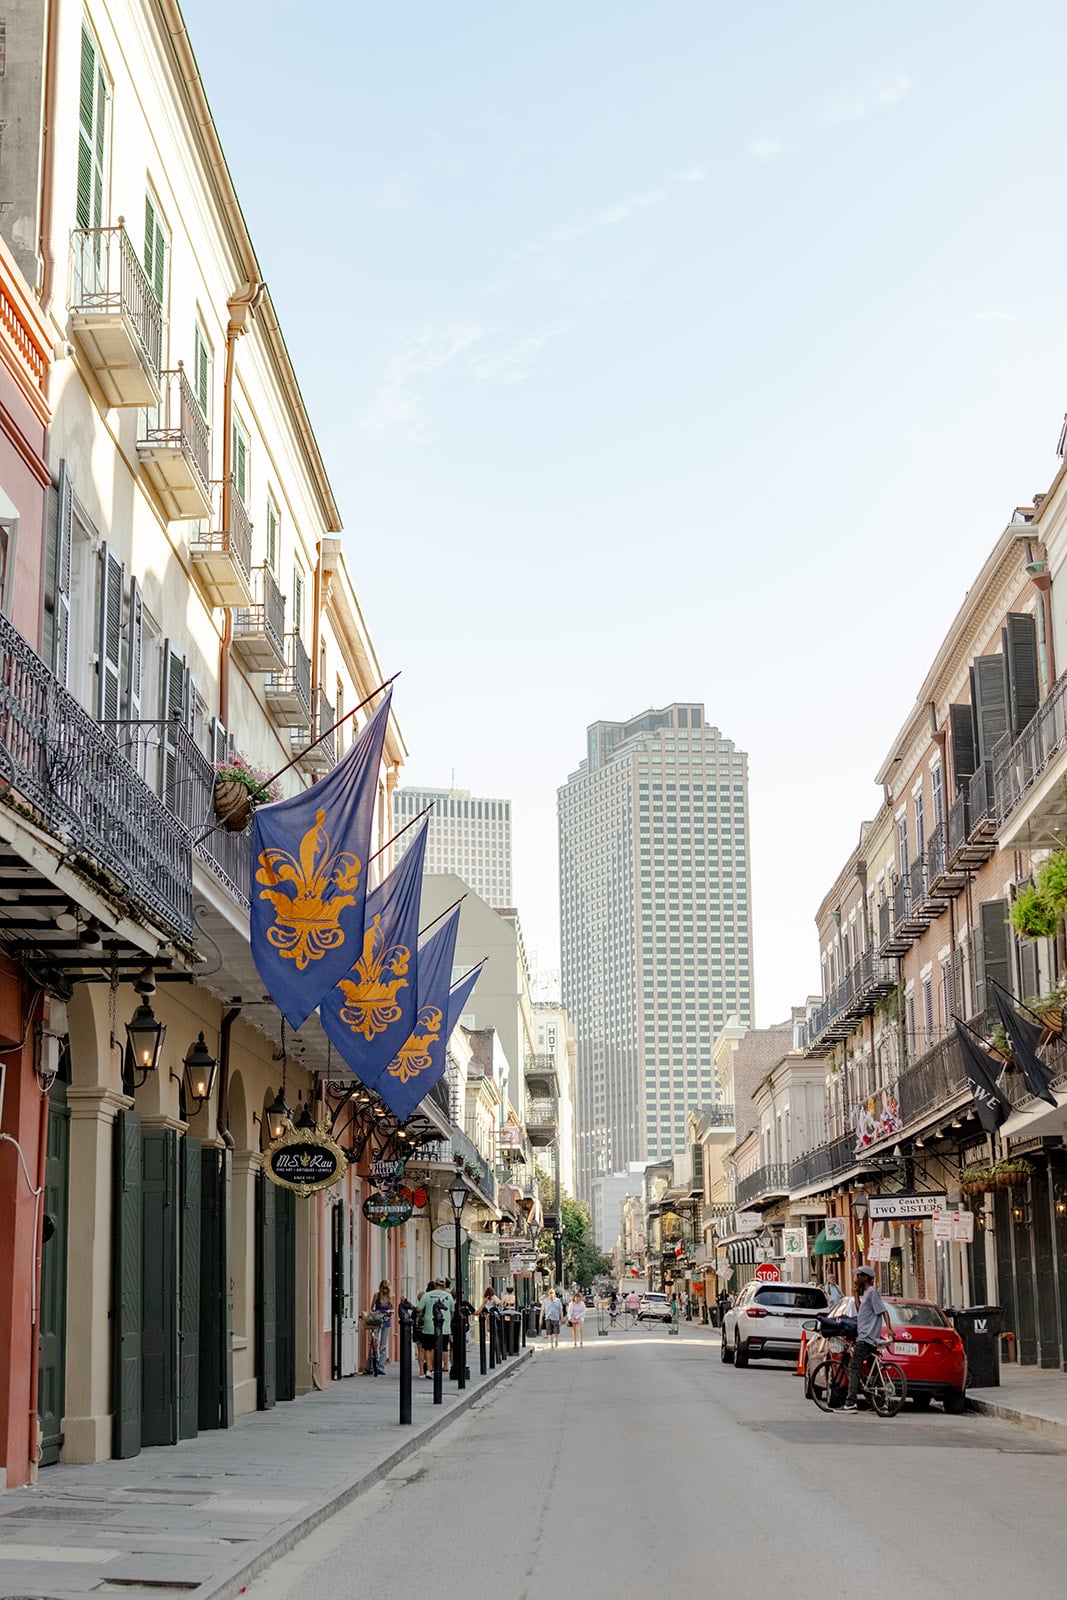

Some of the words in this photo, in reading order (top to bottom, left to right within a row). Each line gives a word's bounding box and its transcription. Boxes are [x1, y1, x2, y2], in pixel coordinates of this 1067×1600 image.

[309, 1154, 333, 1168] Rau
[873, 1206, 897, 1214] TWO
[900, 1204, 943, 1214] SISTERS
[757, 1271, 778, 1281] STOP
